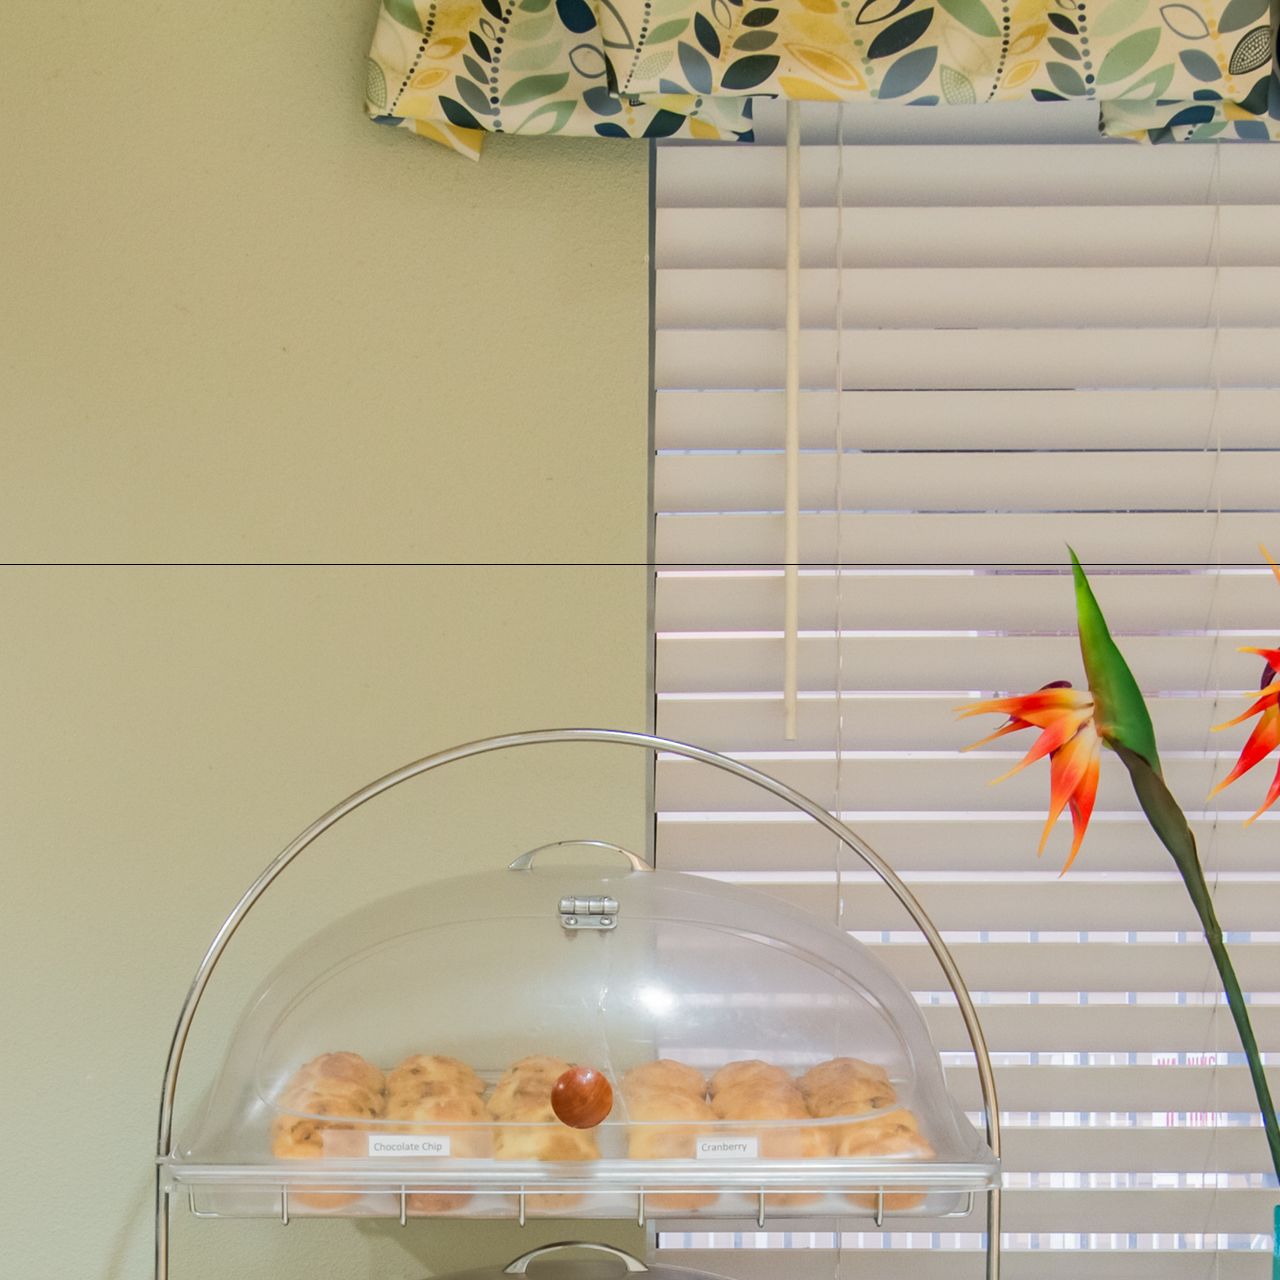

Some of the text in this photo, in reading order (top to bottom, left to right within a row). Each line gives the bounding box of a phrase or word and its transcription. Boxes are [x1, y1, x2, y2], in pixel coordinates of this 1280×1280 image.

[374, 1142, 442, 1152] Chocolate Chip
[701, 1143, 747, 1152] Cranberry
